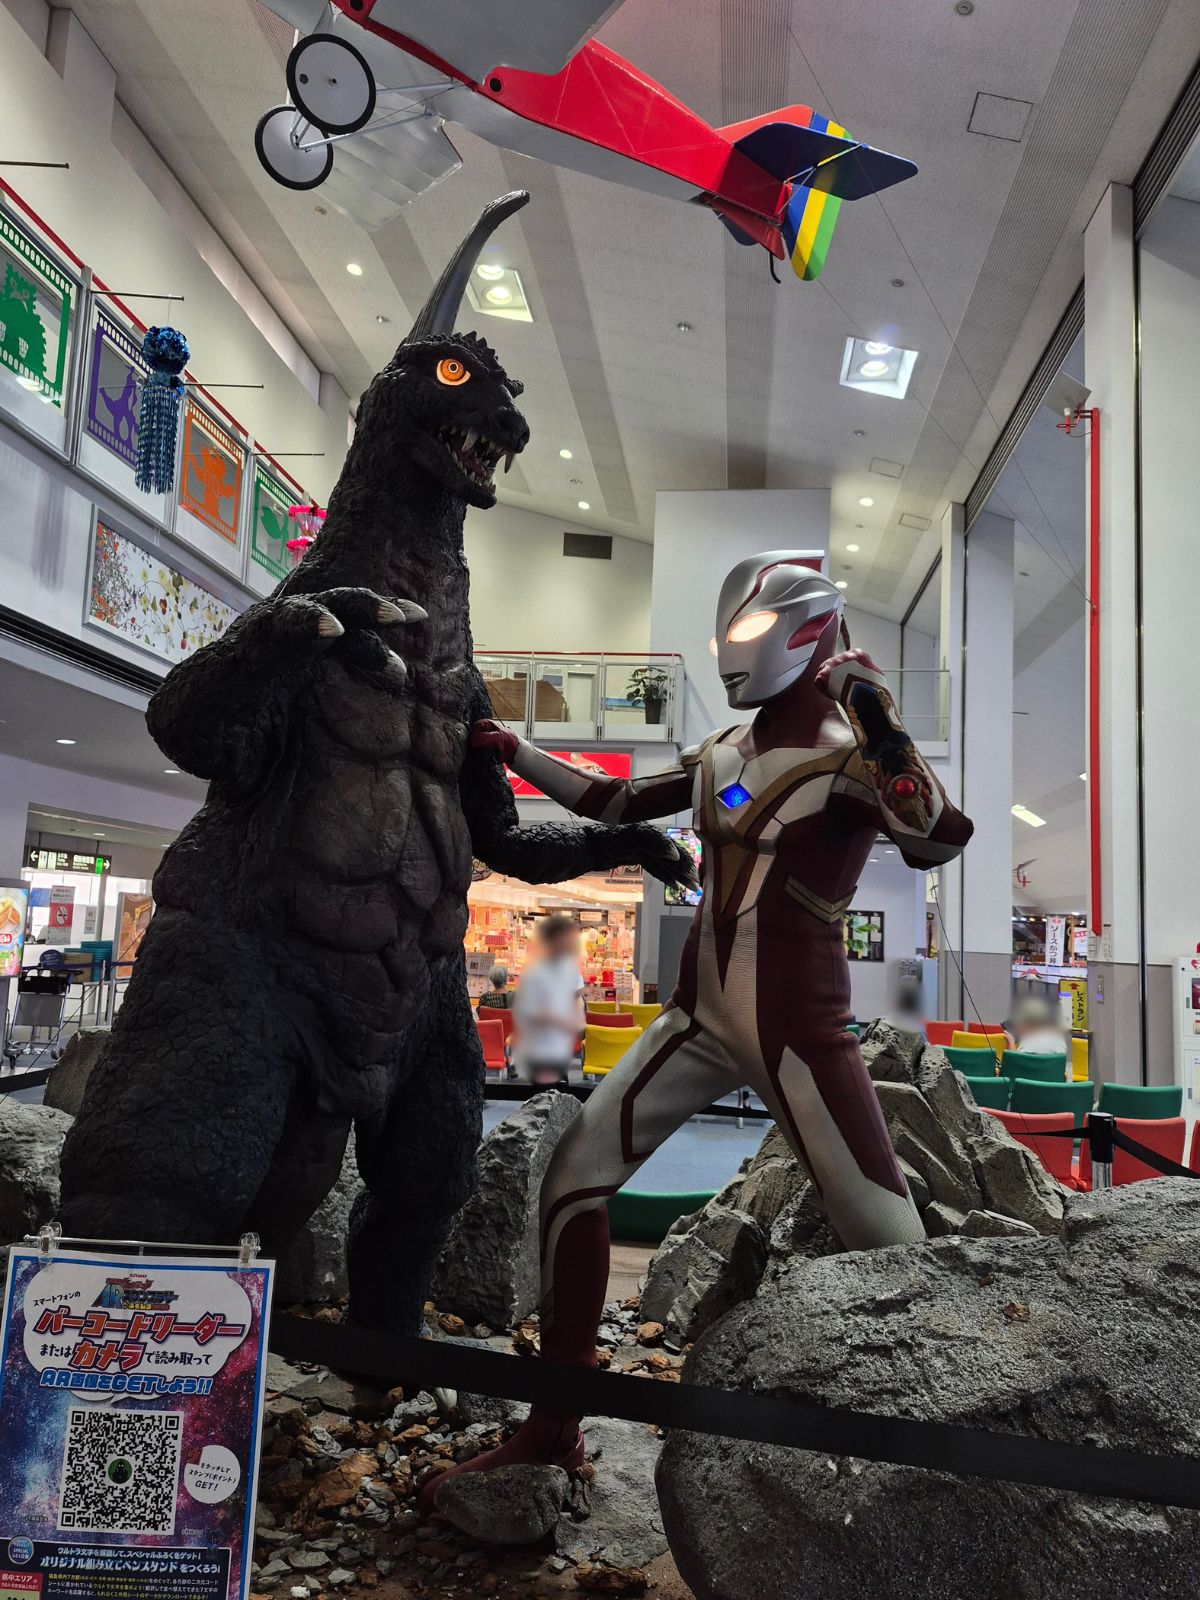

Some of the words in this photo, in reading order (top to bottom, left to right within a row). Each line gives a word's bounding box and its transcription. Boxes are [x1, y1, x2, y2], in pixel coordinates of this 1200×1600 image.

[1077, 990, 1085, 1021] レストラン
[33, 1291, 81, 1306] スマートフォンの
[33, 1305, 246, 1346] バーコードリーダー
[201, 1462, 231, 1473] をタッチして
[195, 1480, 219, 1491] GET!
